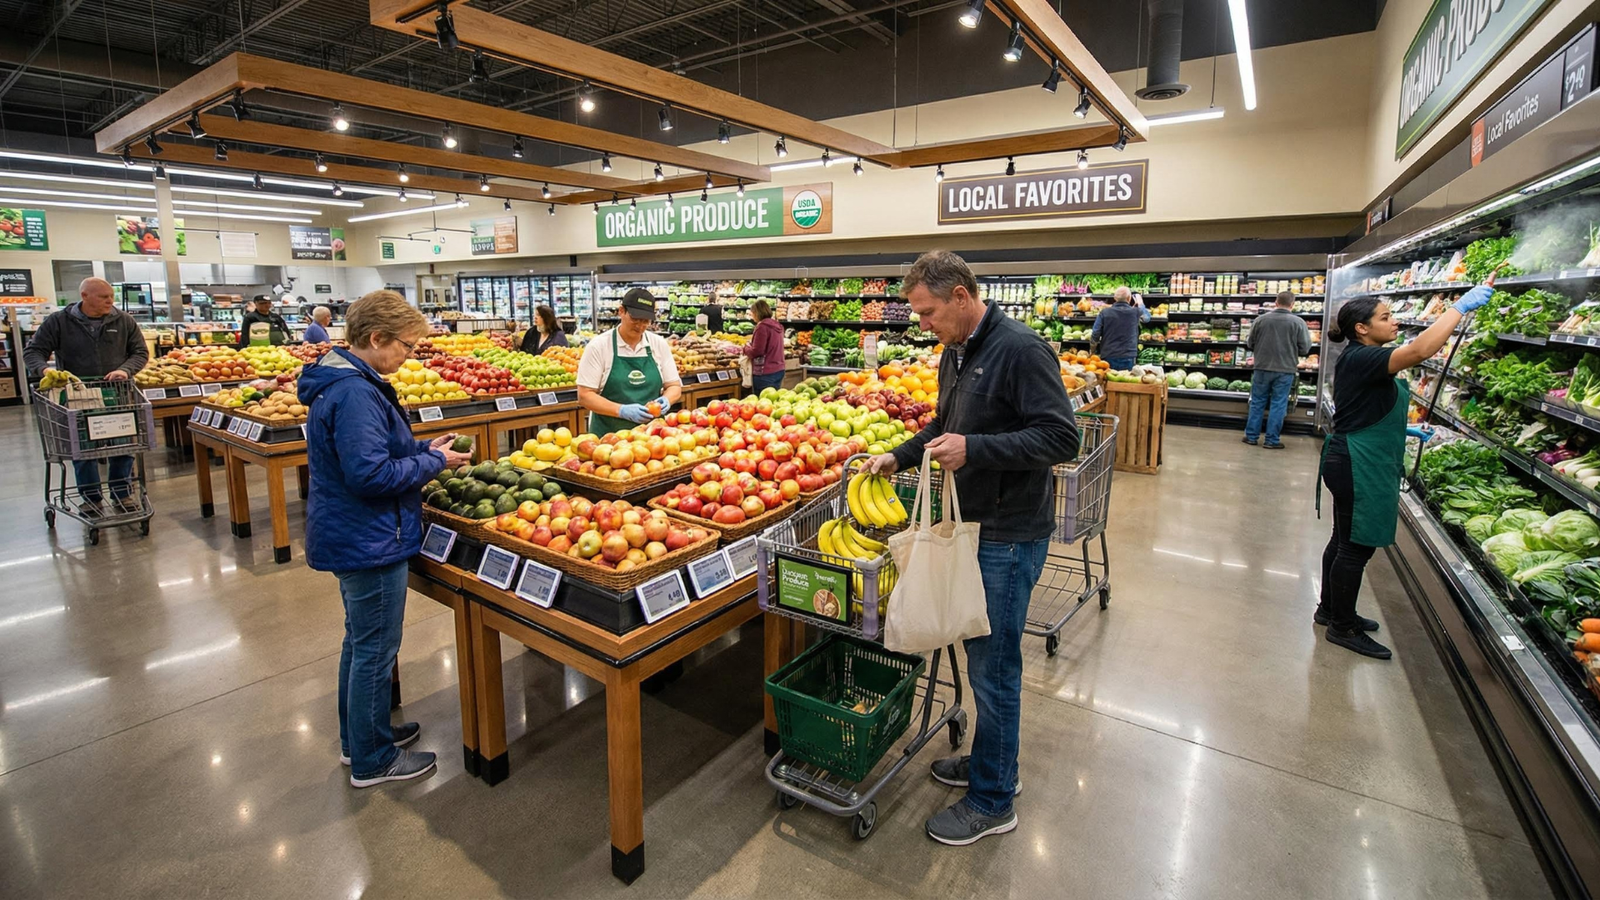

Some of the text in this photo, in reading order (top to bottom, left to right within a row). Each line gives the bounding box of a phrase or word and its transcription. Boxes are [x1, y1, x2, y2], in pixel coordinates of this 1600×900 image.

[1400, 15, 1446, 129] ORGANIC
[1487, 113, 1505, 145] Local
[798, 198, 816, 208] USDA
[948, 173, 1132, 213] LOCAL FAVORITES
[605, 197, 769, 239] ORGANIC PRODUCE
